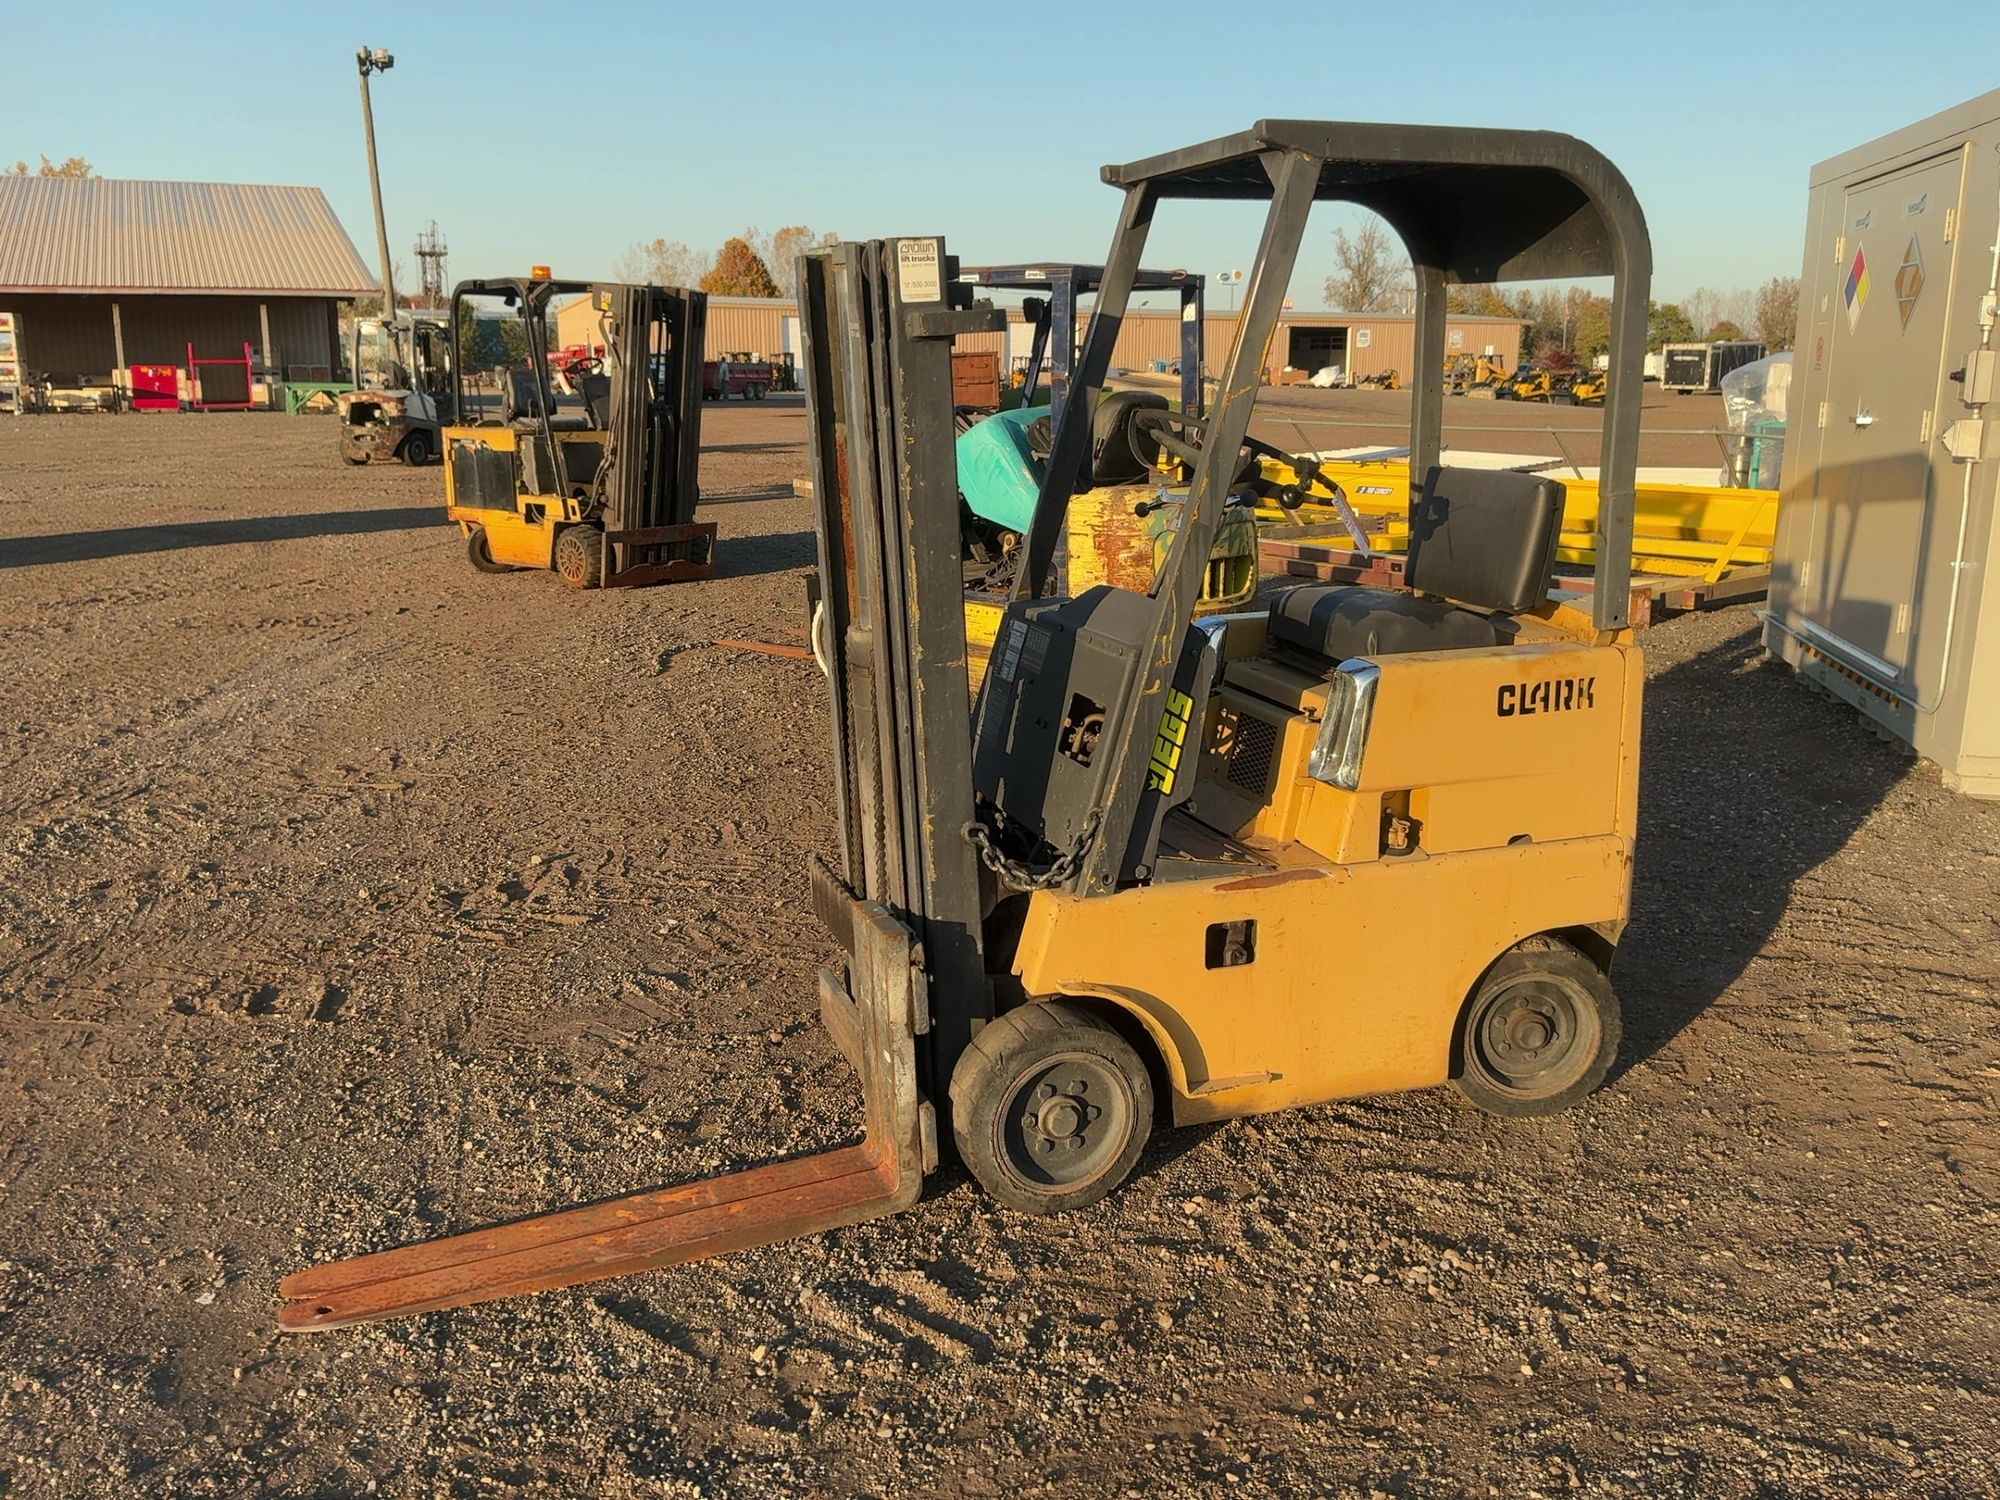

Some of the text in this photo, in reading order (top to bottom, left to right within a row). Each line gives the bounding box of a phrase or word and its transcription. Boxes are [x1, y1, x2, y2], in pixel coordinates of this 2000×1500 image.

[900, 243, 935, 253] CROWN
[911, 254, 935, 262] trucks
[1497, 676, 1596, 717] CLARK
[1148, 687, 1193, 795] JEGS
